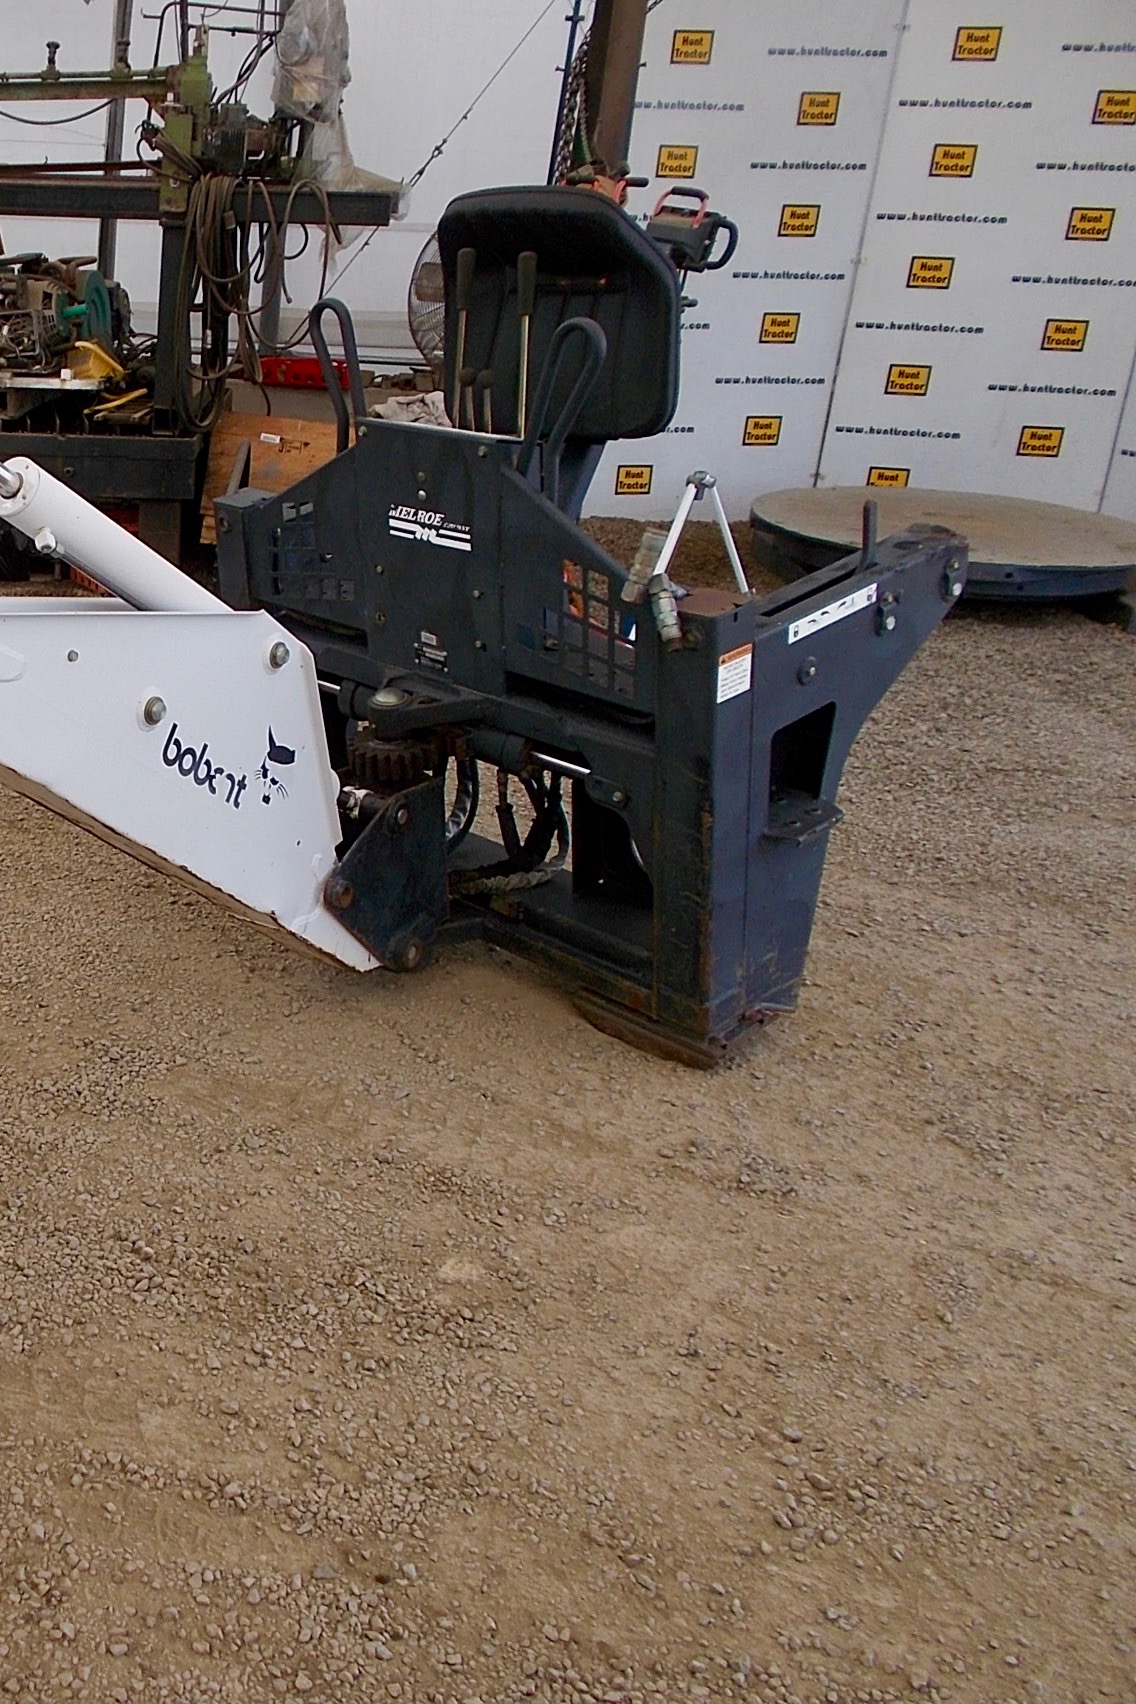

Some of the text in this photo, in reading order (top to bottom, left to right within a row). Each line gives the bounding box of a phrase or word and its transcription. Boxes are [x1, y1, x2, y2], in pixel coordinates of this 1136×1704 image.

[682, 35, 703, 46] Hunt
[966, 32, 990, 43] Hunt
[675, 48, 708, 58] Tractor
[768, 46, 888, 57] www.hunttractor.com
[958, 45, 994, 55] Tractor
[634, 99, 745, 111] ww.hunttractor.com
[809, 97, 830, 107] Hunt
[898, 98, 1032, 109] www.hunttractor.com
[1106, 96, 1131, 106] Hunt
[802, 110, 834, 119] Tractor
[1098, 109, 1135, 119] Tractor
[667, 150, 688, 160] Hunt
[942, 149, 966, 159] Hunt
[660, 162, 692, 172] Tractor
[750, 160, 867, 171] www.hunttractor.com
[935, 161, 970, 172] Tractor
[789, 210, 810, 219] Hunt
[876, 211, 1008, 224] www.hunttractor.com
[1079, 213, 1103, 223] Hunt
[783, 222, 814, 231] Tractor
[1071, 225, 1107, 236] Tractor
[920, 262, 944, 271] Hunt
[732, 269, 846, 280] www.hunttractor.com
[912, 273, 948, 284] Tractor
[770, 318, 791, 327] Hunt
[855, 320, 984, 334] www.hunttractor.com
[764, 329, 794, 338] Tractor
[1054, 325, 1078, 334] Hunt
[1046, 335, 1082, 346] Tractor
[898, 369, 920, 379] Hunt
[715, 375, 825, 386] www.hunttractor.com
[890, 380, 925, 390] Tractor
[988, 383, 1117, 396] www.hunttractor.com
[753, 421, 773, 429] Hunt
[747, 431, 776, 440] Tractor
[835, 425, 961, 439] www.hunttractor.com
[1030, 431, 1053, 440] Hunt
[1022, 441, 1057, 452] Tractor
[625, 470, 644, 479] Hunt
[877, 472, 899, 482] Hunt
[619, 480, 648, 489] Tractor
